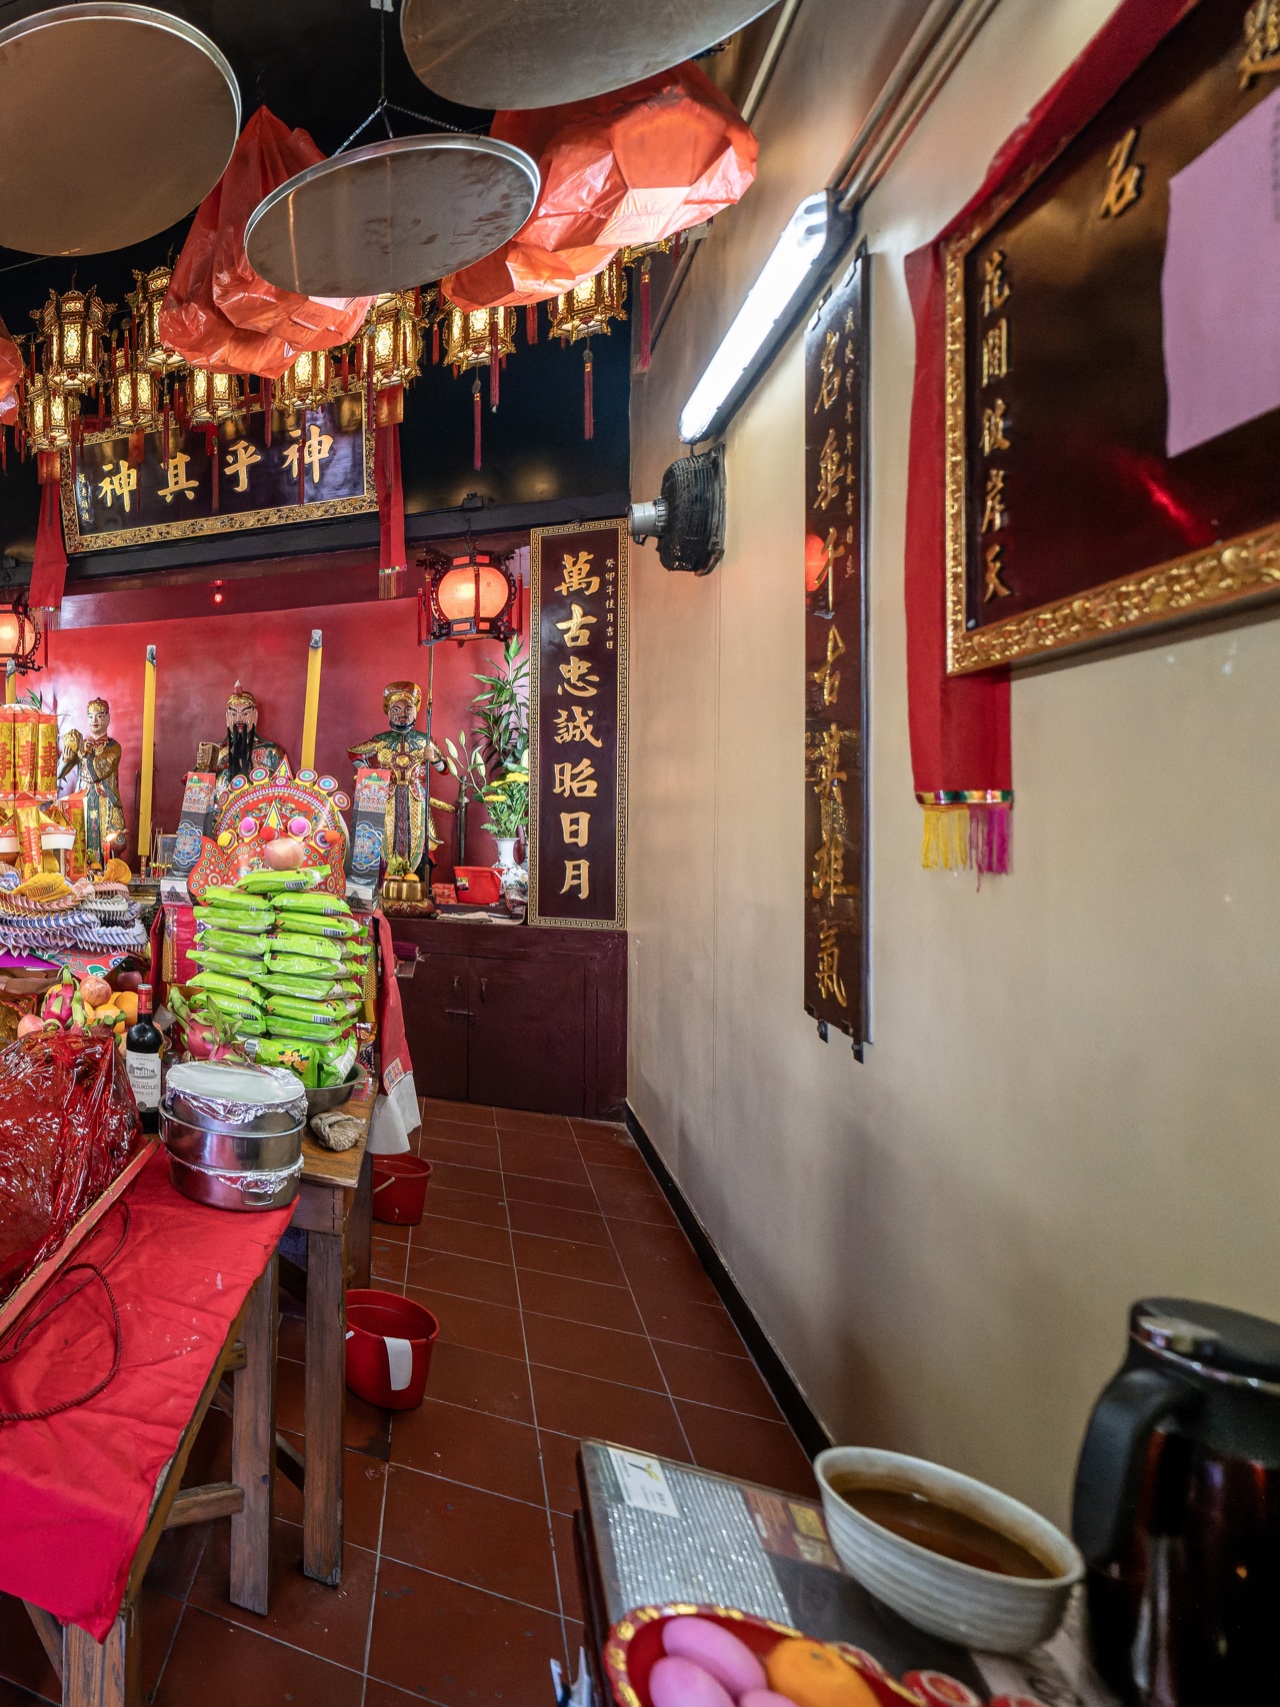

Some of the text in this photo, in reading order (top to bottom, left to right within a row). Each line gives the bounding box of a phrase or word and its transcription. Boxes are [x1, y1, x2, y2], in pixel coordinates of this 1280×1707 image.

[98, 424, 334, 513] 神乎其神
[553, 551, 602, 901] 萬古忠誠昭日月
